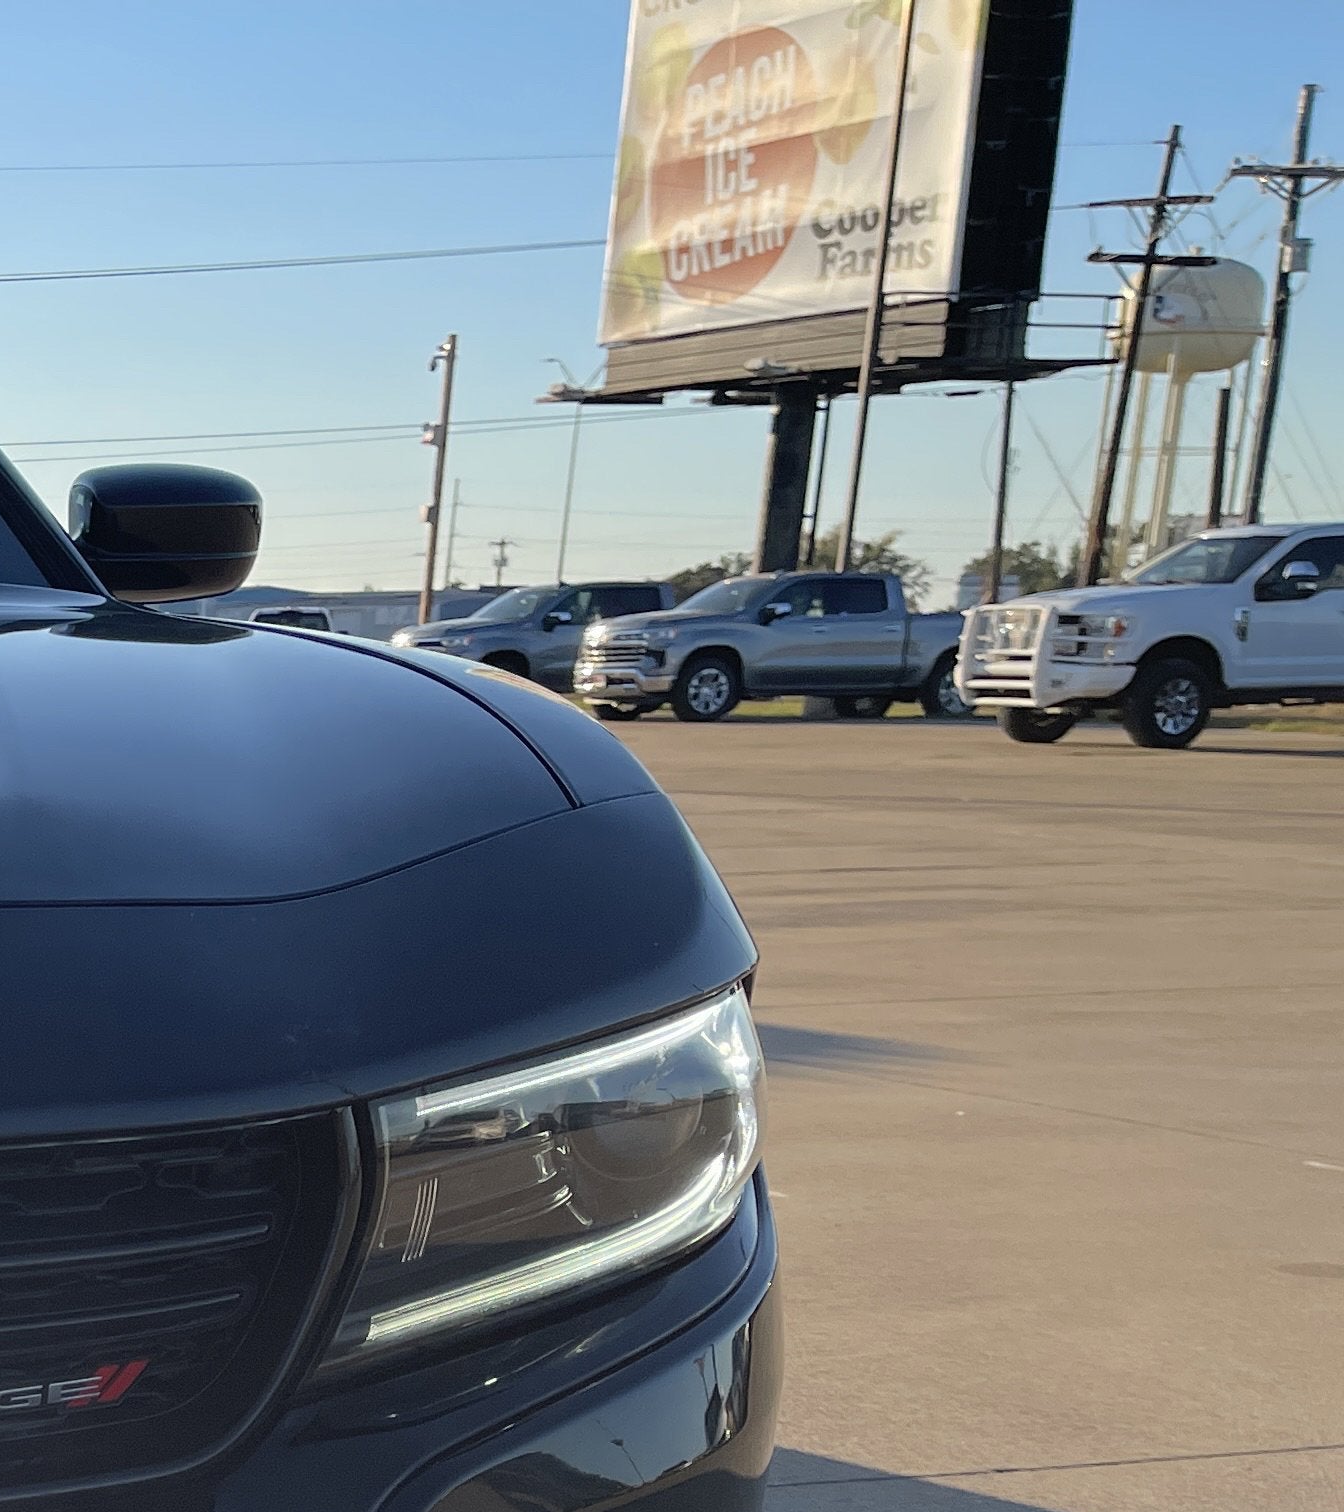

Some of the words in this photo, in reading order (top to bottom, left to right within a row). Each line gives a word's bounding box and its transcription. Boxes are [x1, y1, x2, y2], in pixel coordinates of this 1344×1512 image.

[681, 44, 795, 147] PEACH
[704, 127, 759, 205] ICE
[667, 183, 790, 282] CREAM
